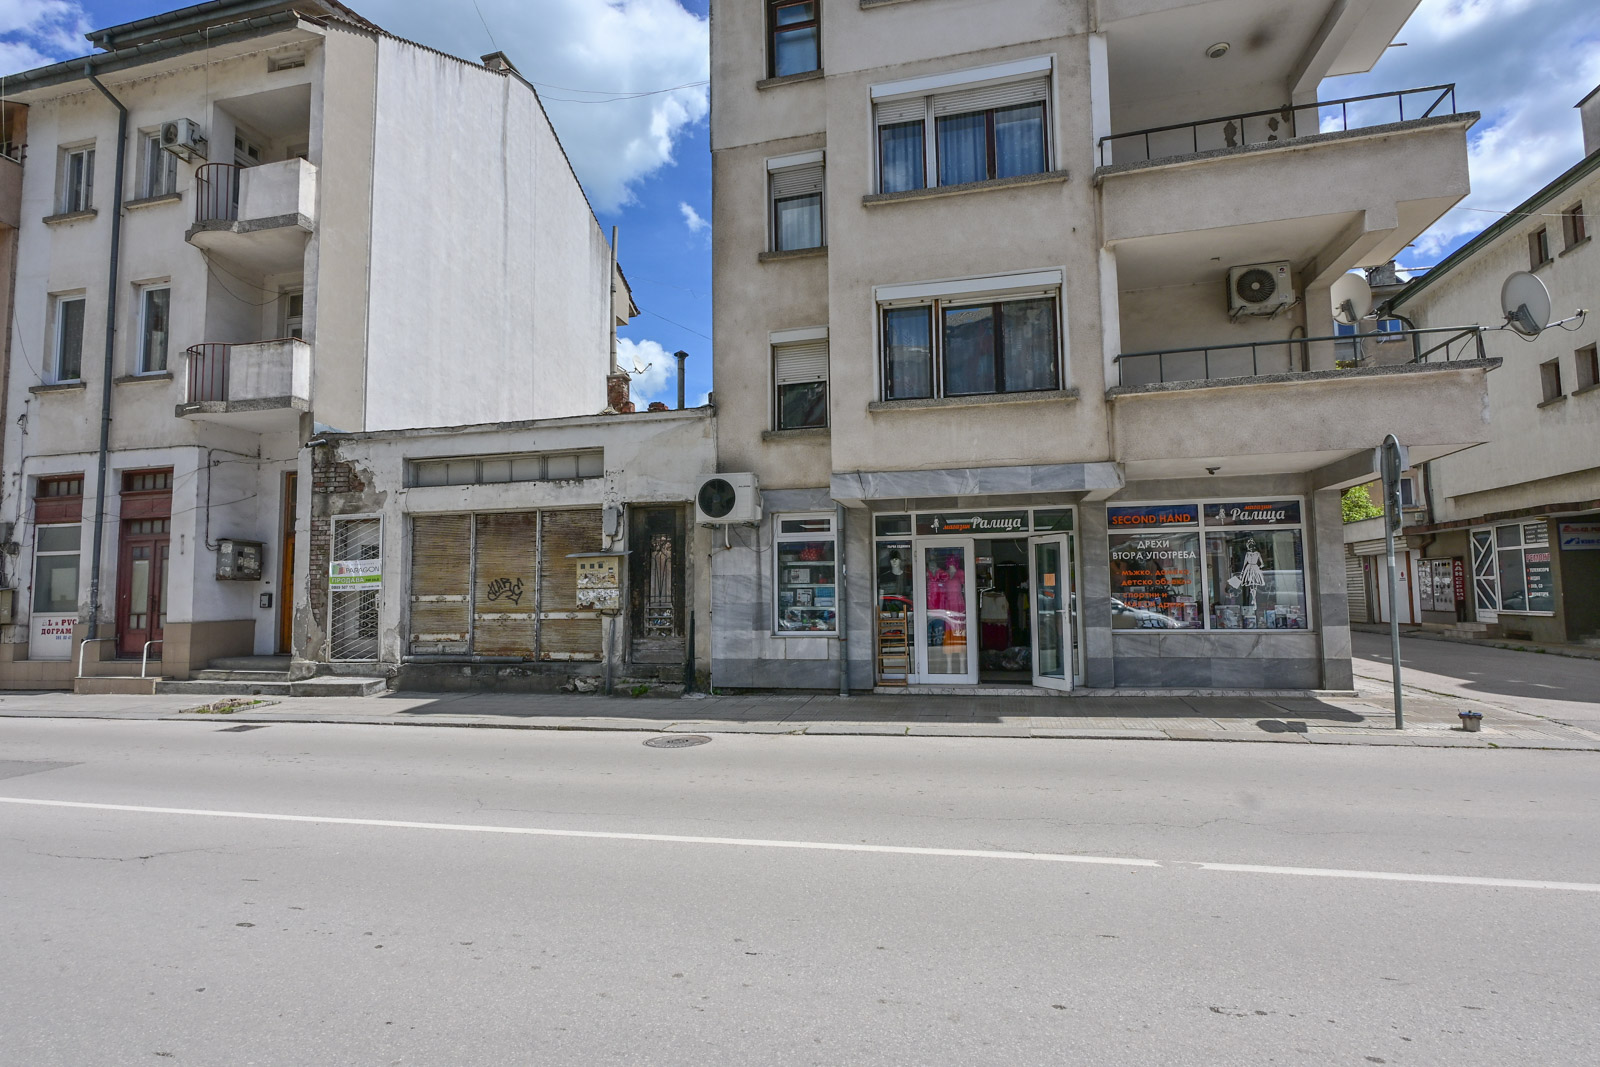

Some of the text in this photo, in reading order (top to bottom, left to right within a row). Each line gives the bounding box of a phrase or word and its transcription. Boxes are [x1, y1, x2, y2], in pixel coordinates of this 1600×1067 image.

[1112, 513, 1191, 525] SECOND HAND
[1230, 508, 1285, 523] Ралица
[971, 516, 1021, 531] Ралица
[1137, 539, 1169, 549] ДРЕХИ
[1112, 551, 1196, 560] ВТОРА УПОТРЕБА
[346, 566, 379, 574] PARAGON
